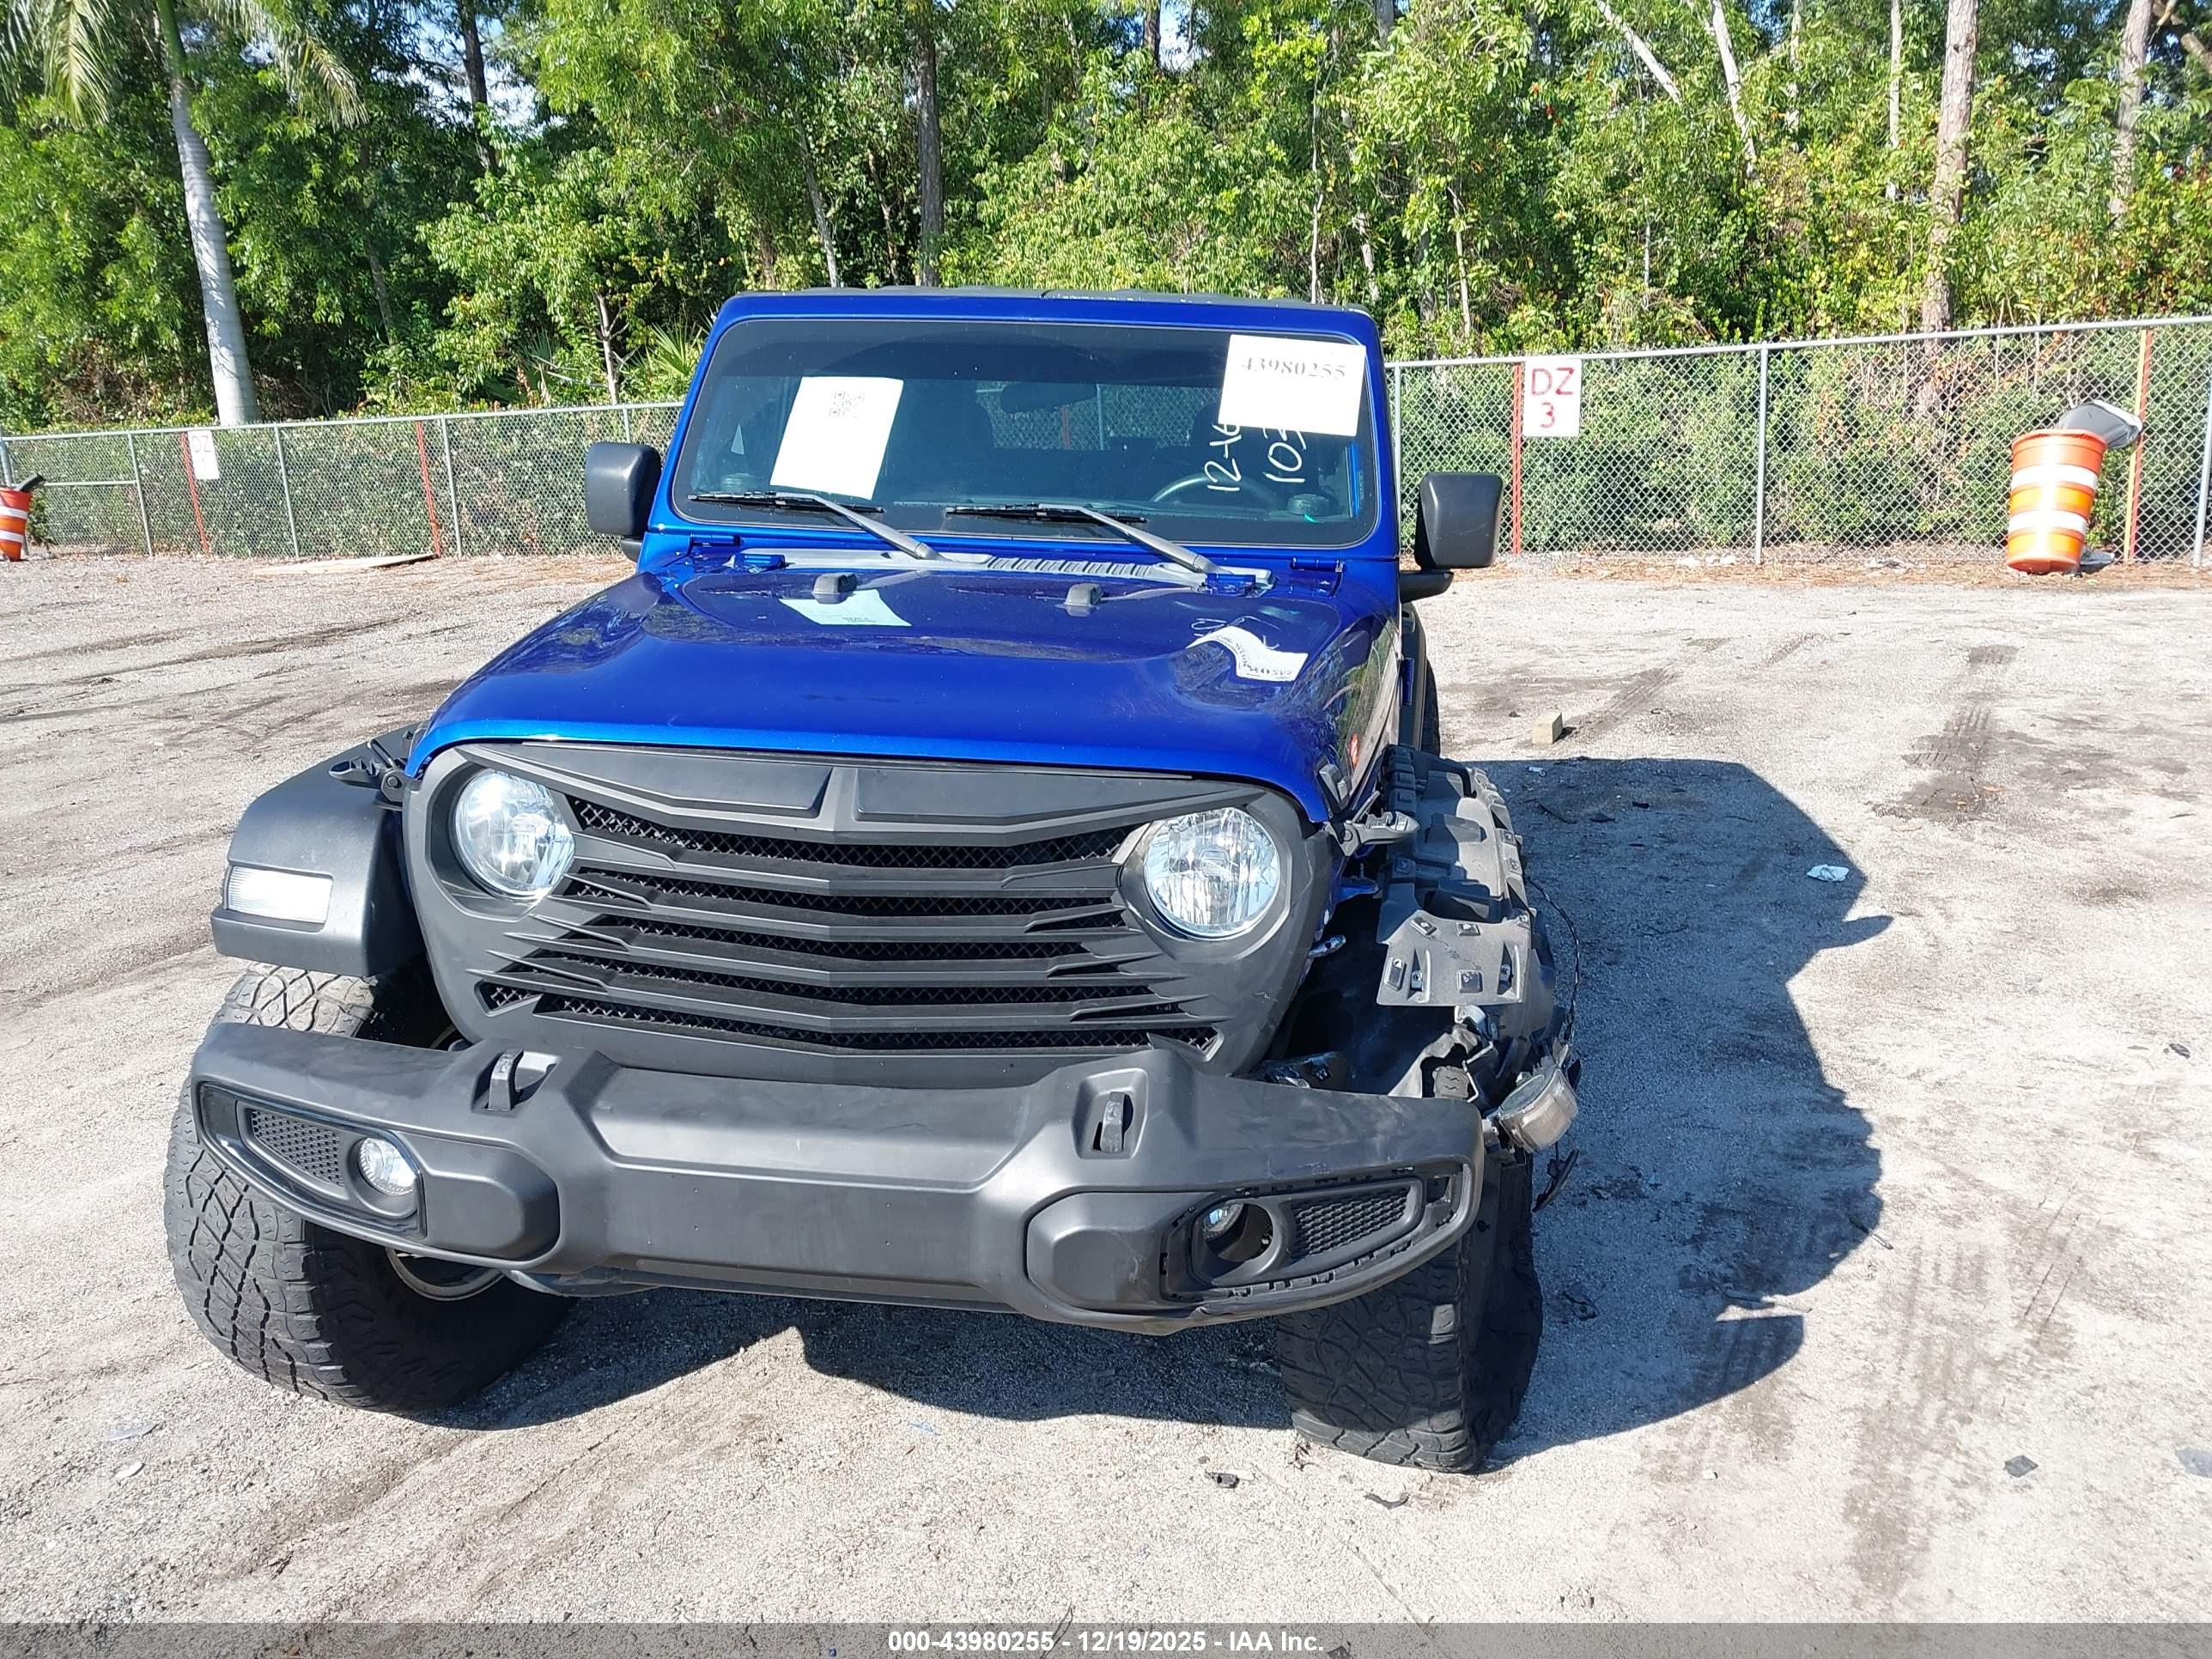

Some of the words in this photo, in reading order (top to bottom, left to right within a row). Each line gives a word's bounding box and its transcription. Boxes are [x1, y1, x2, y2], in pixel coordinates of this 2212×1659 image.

[1242, 356, 1346, 379] 43980255
[1531, 367, 1575, 396] DZ
[1540, 402, 1555, 428] 3
